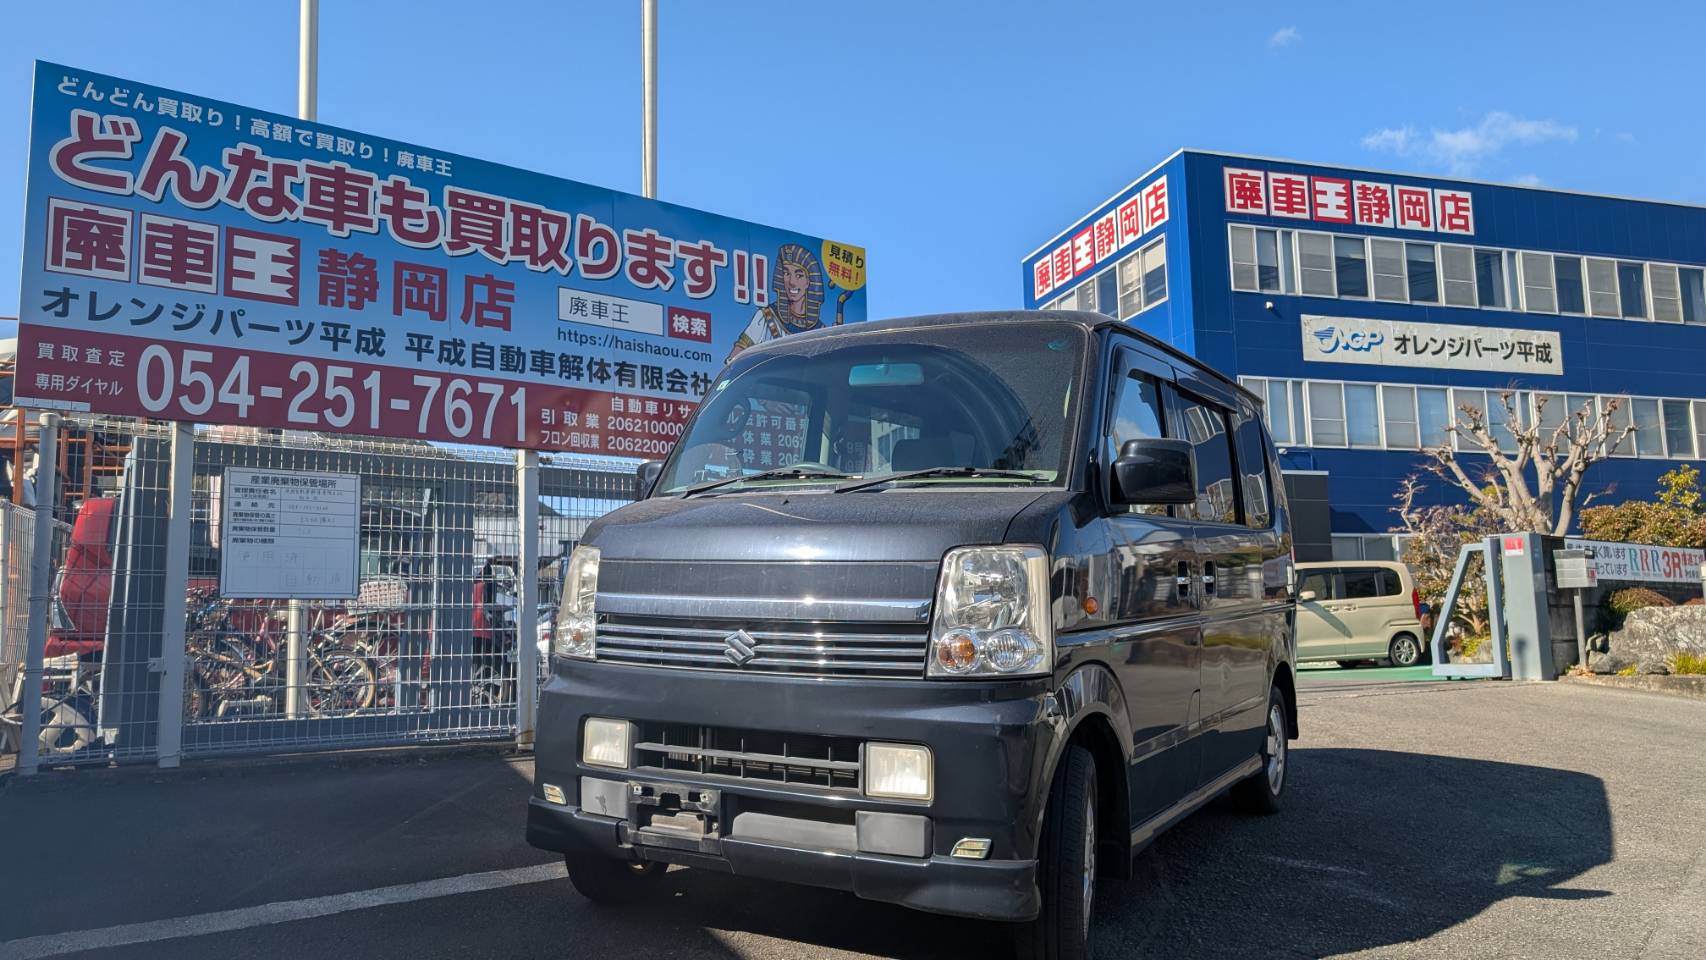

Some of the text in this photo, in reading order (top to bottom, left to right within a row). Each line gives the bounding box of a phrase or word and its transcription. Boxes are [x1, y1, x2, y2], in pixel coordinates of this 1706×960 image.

[829, 244, 864, 269] 見積り
[42, 287, 387, 356] オレンジパーツ平成
[568, 296, 709, 337] 廃車王 検索
[37, 341, 126, 369] 買取査定
[557, 327, 713, 363] https://haishaou.com
[1394, 334, 1553, 364] オレンジパーツ平成
[35, 372, 124, 396] 専用ダイヤル
[136, 344, 528, 443] 054-251-7671
[541, 430, 600, 450] フロン回収業
